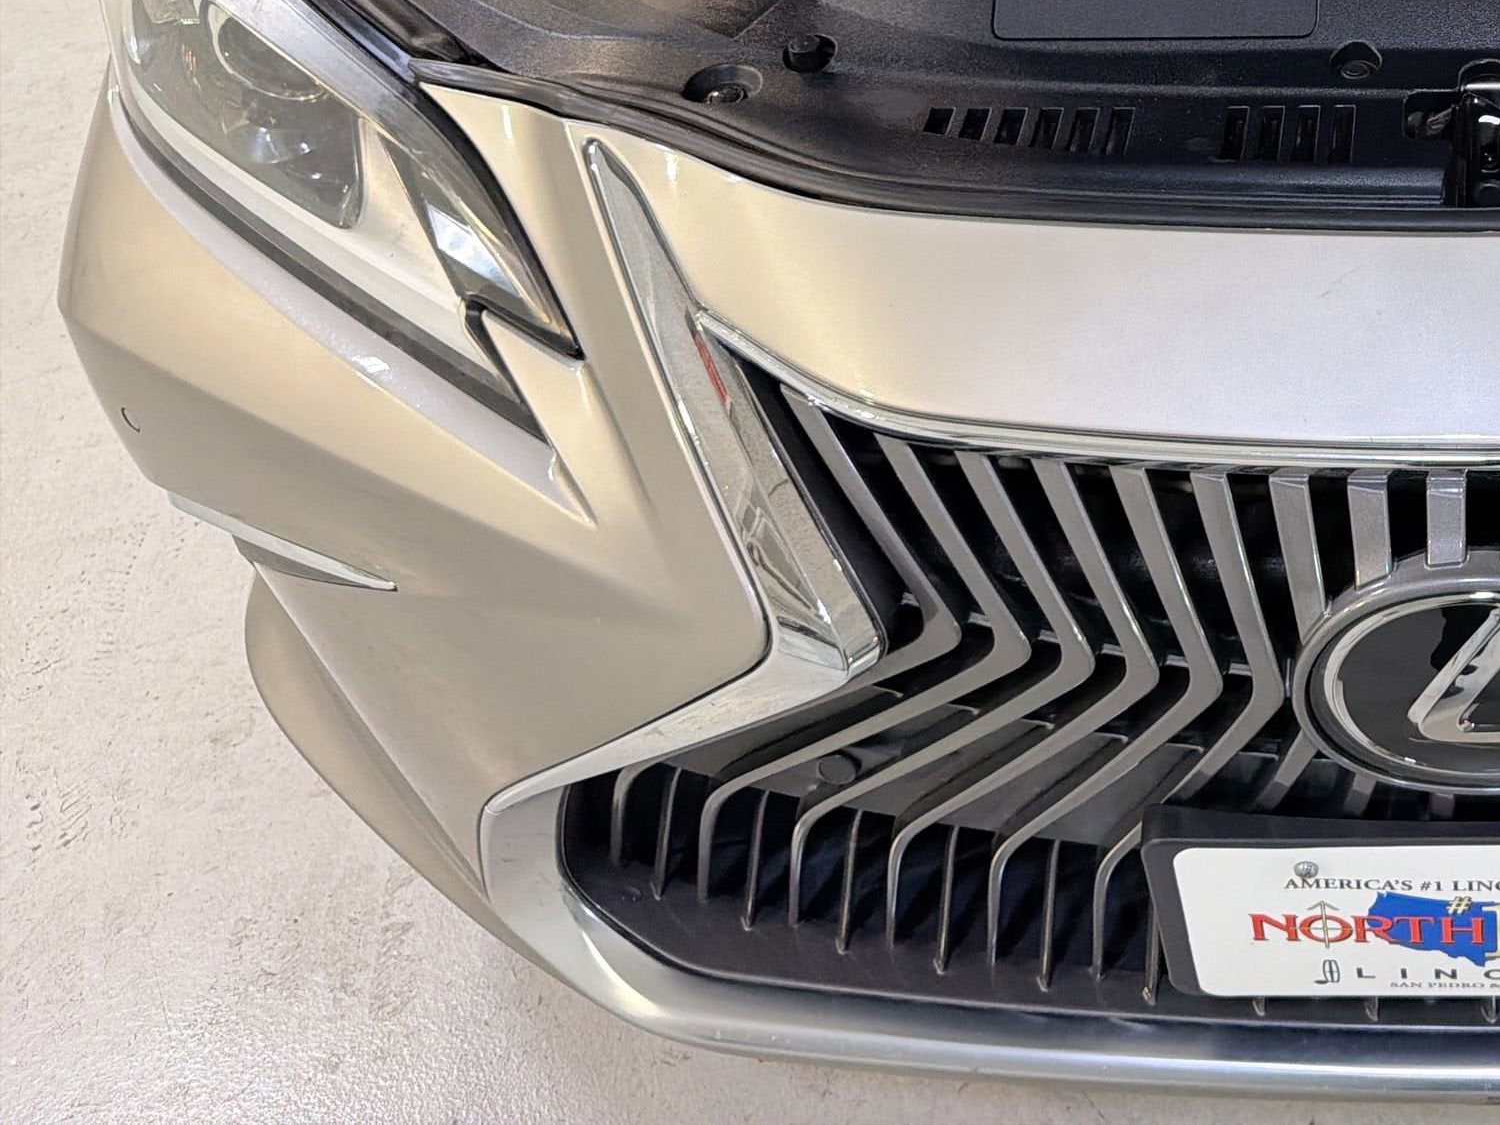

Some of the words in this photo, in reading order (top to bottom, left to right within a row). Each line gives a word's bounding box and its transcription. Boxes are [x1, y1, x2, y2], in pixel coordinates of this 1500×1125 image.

[1284, 877, 1414, 892] AMERICA'S
[1419, 880, 1444, 892] #1
[1248, 912, 1485, 945] NORTH
[1390, 981, 1423, 989] SAN
[1428, 981, 1485, 989] PEDRO
